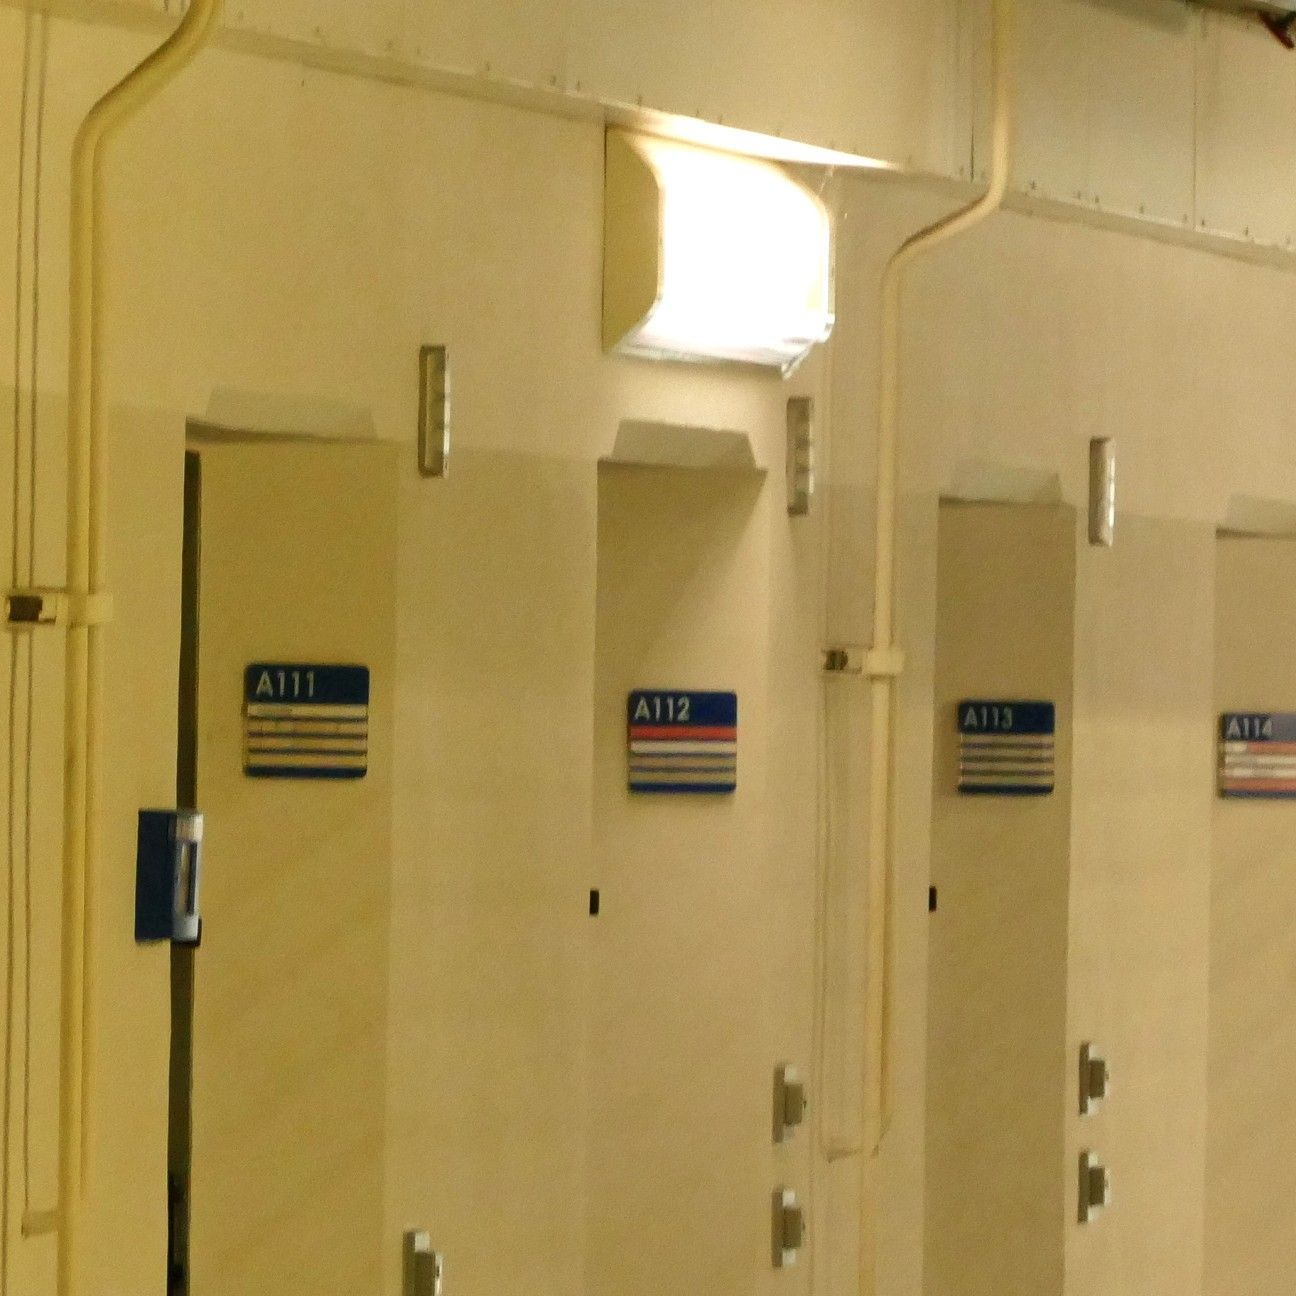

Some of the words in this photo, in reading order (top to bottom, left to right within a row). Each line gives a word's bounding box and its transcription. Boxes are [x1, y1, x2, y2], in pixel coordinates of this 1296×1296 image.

[256, 670, 315, 697] A111
[634, 696, 690, 722] A112
[964, 705, 1012, 729] A113
[1226, 717, 1272, 739] A114
